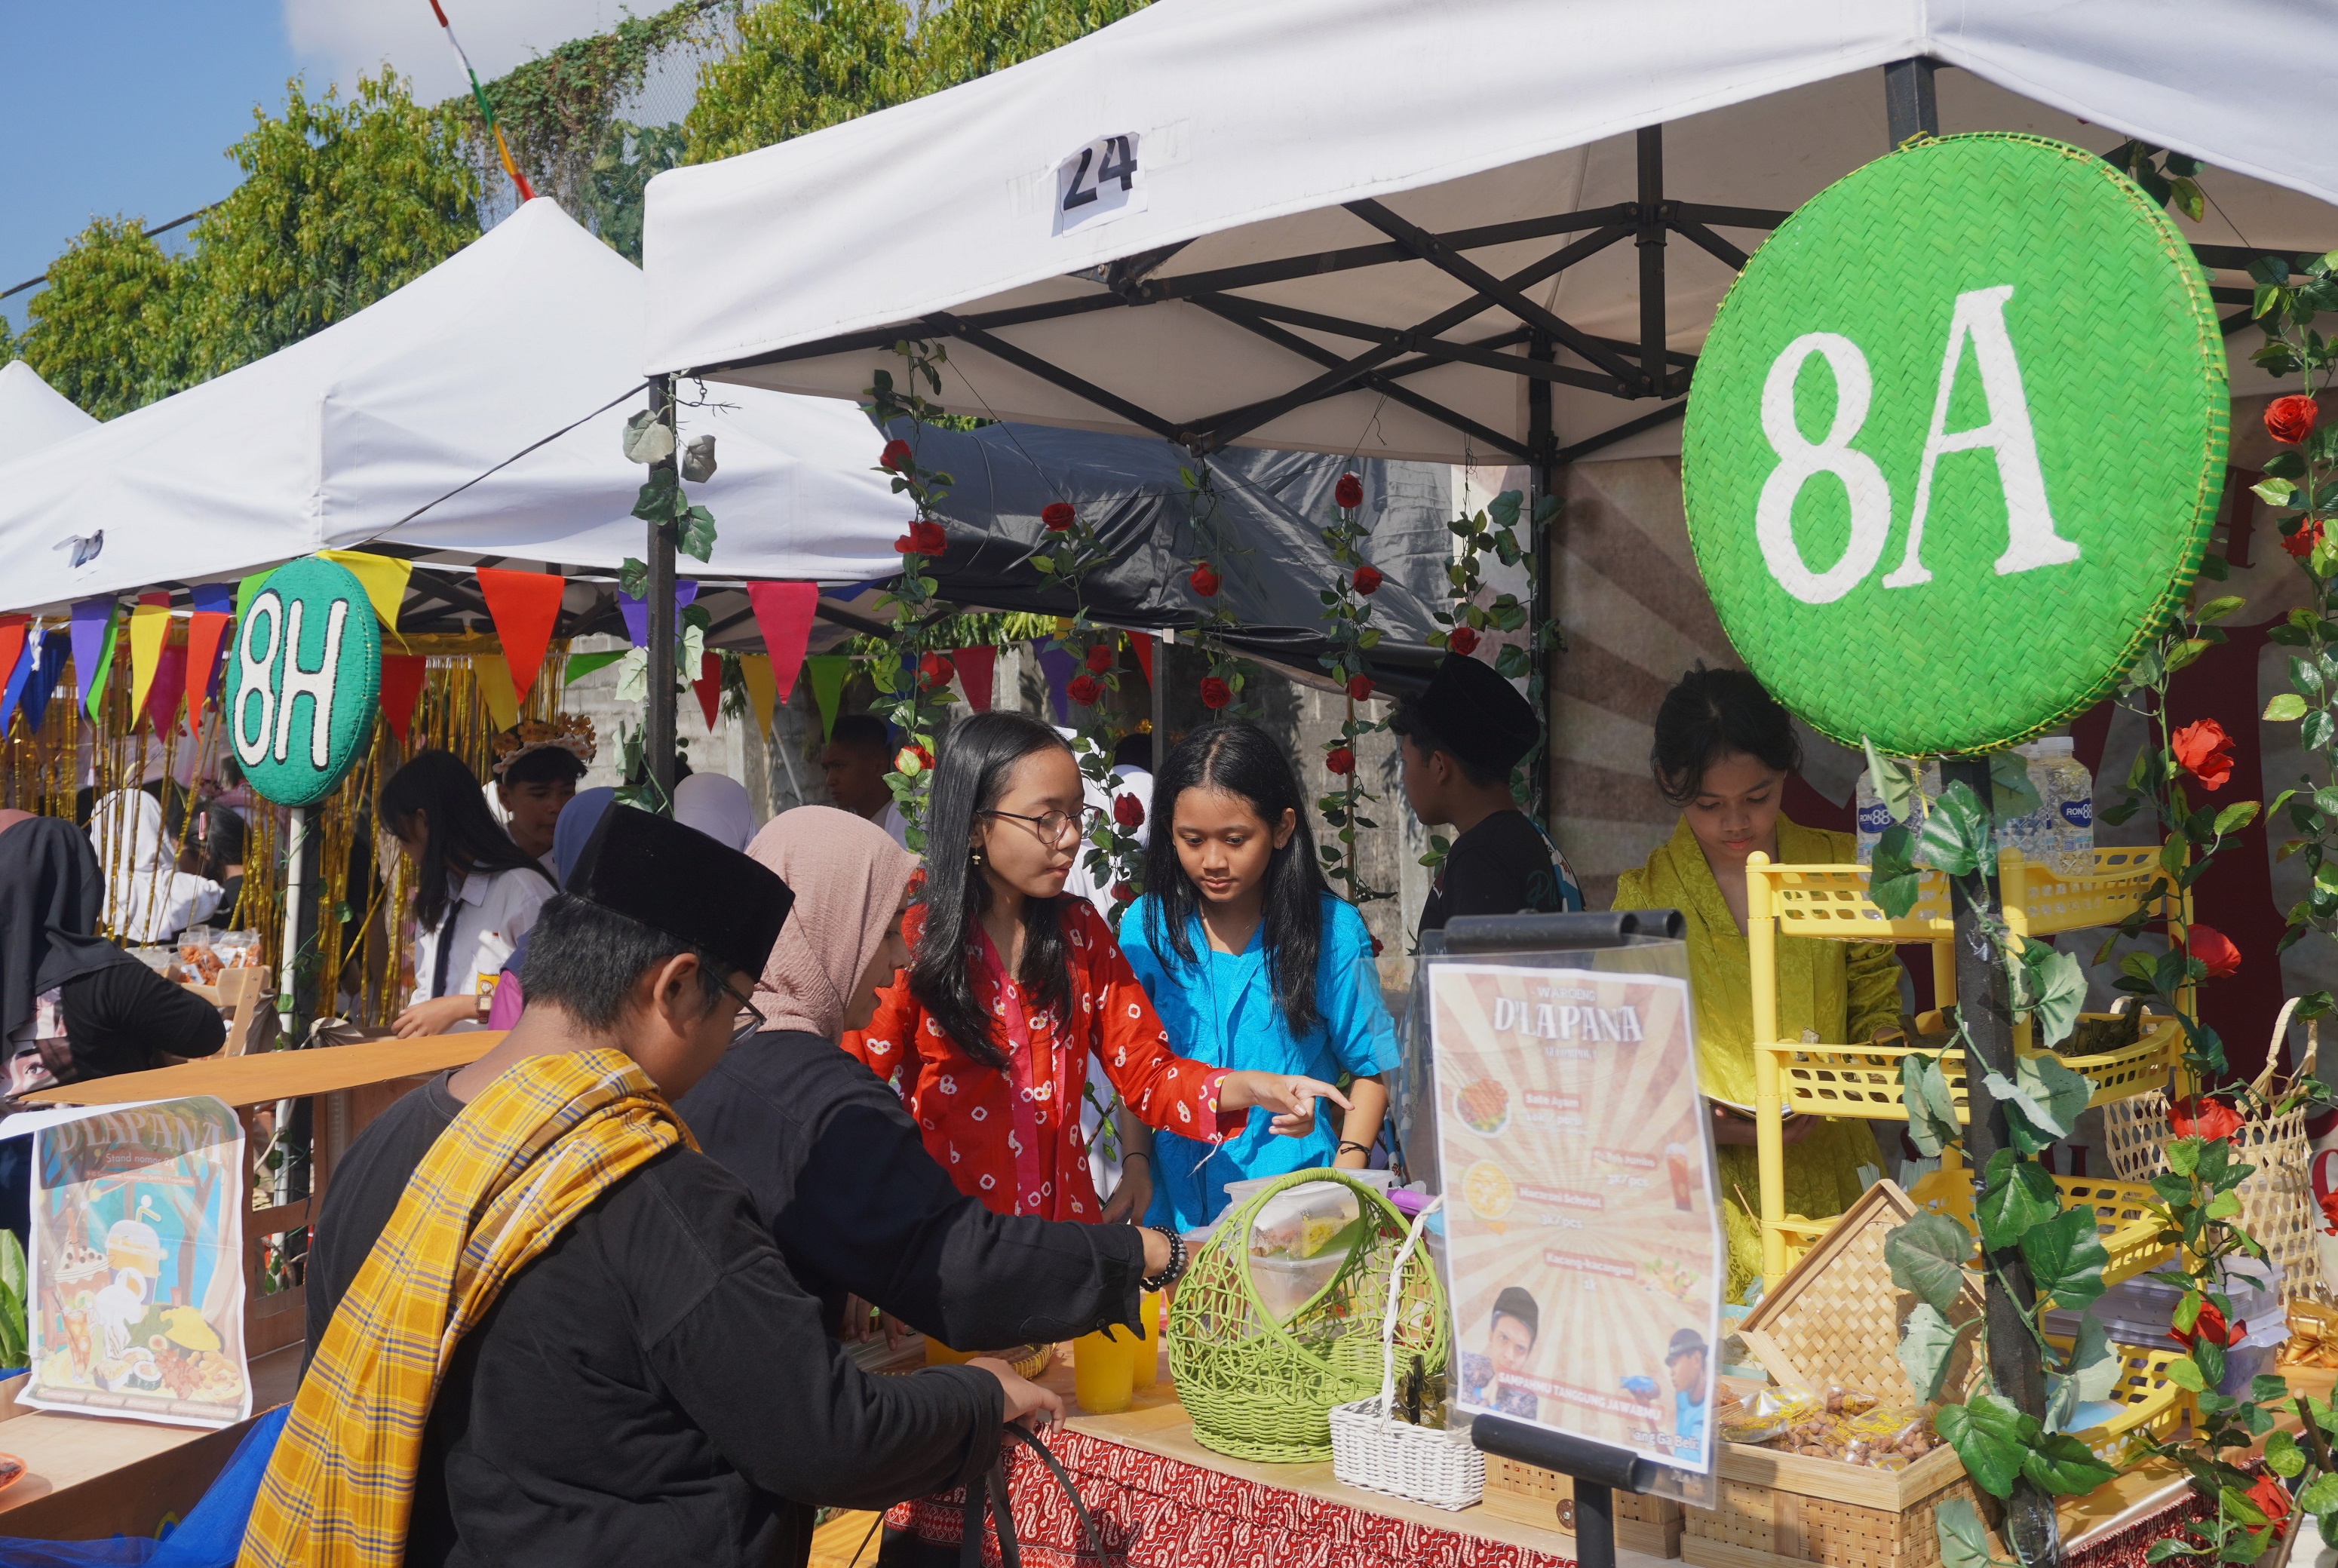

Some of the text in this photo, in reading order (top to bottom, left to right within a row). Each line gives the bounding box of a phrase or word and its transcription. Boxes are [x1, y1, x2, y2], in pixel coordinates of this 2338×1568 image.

[1063, 136, 1137, 211] 24
[1755, 284, 2081, 605] 8A
[233, 588, 348, 772] 8H
[1536, 987, 1596, 1002] WAROENG
[106, 1152, 131, 1164] Stand
[134, 1155, 161, 1165] nomor
[1498, 1373, 1552, 1395] SAMPAHMU
[1606, 1398, 1662, 1421] JAWABMU
